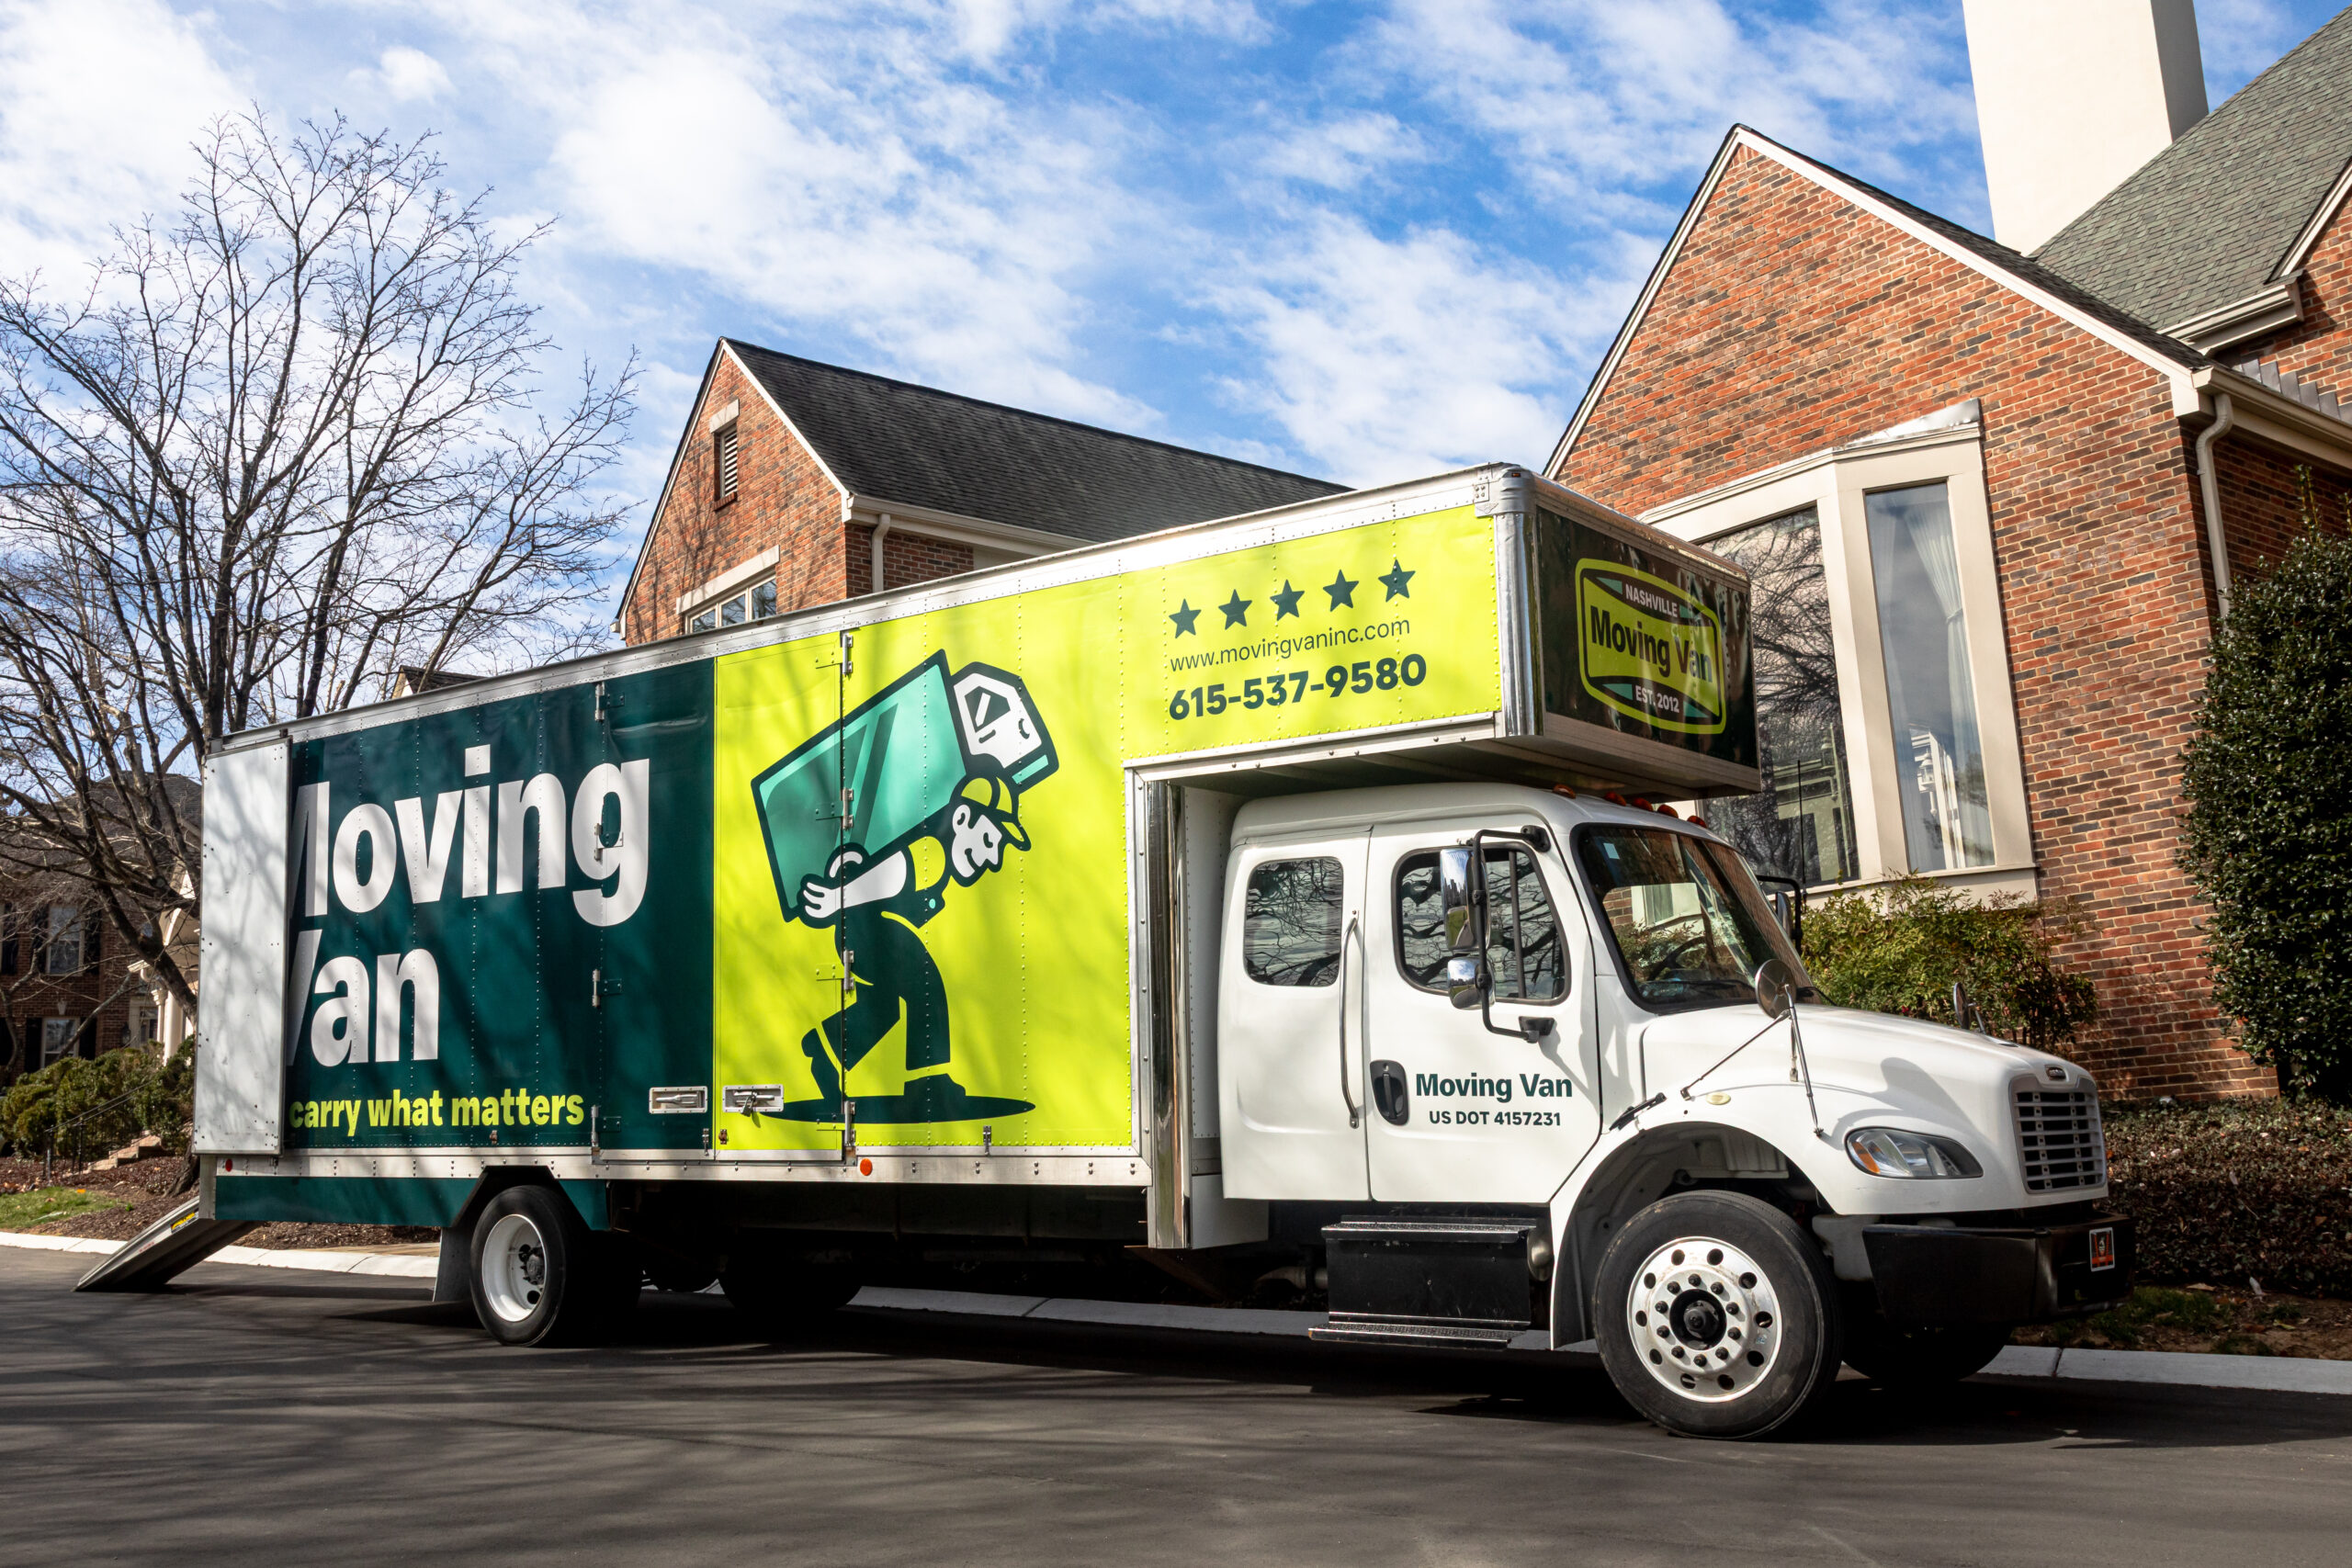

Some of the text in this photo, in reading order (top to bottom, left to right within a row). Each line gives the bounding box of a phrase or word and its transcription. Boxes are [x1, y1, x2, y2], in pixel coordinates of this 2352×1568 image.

[1625, 584, 1678, 618] NASHVILLE
[1170, 619, 1410, 672] www.movingvaninc.com
[1590, 606, 1713, 683] Moving Van
[1169, 653, 1427, 721] 615-537-9580
[1635, 685, 1679, 713] EST. 2012
[1416, 1072, 1572, 1102] Moving Van
[288, 1088, 584, 1137] carry what matters
[1429, 1111, 1561, 1126] US DOT 4157231
